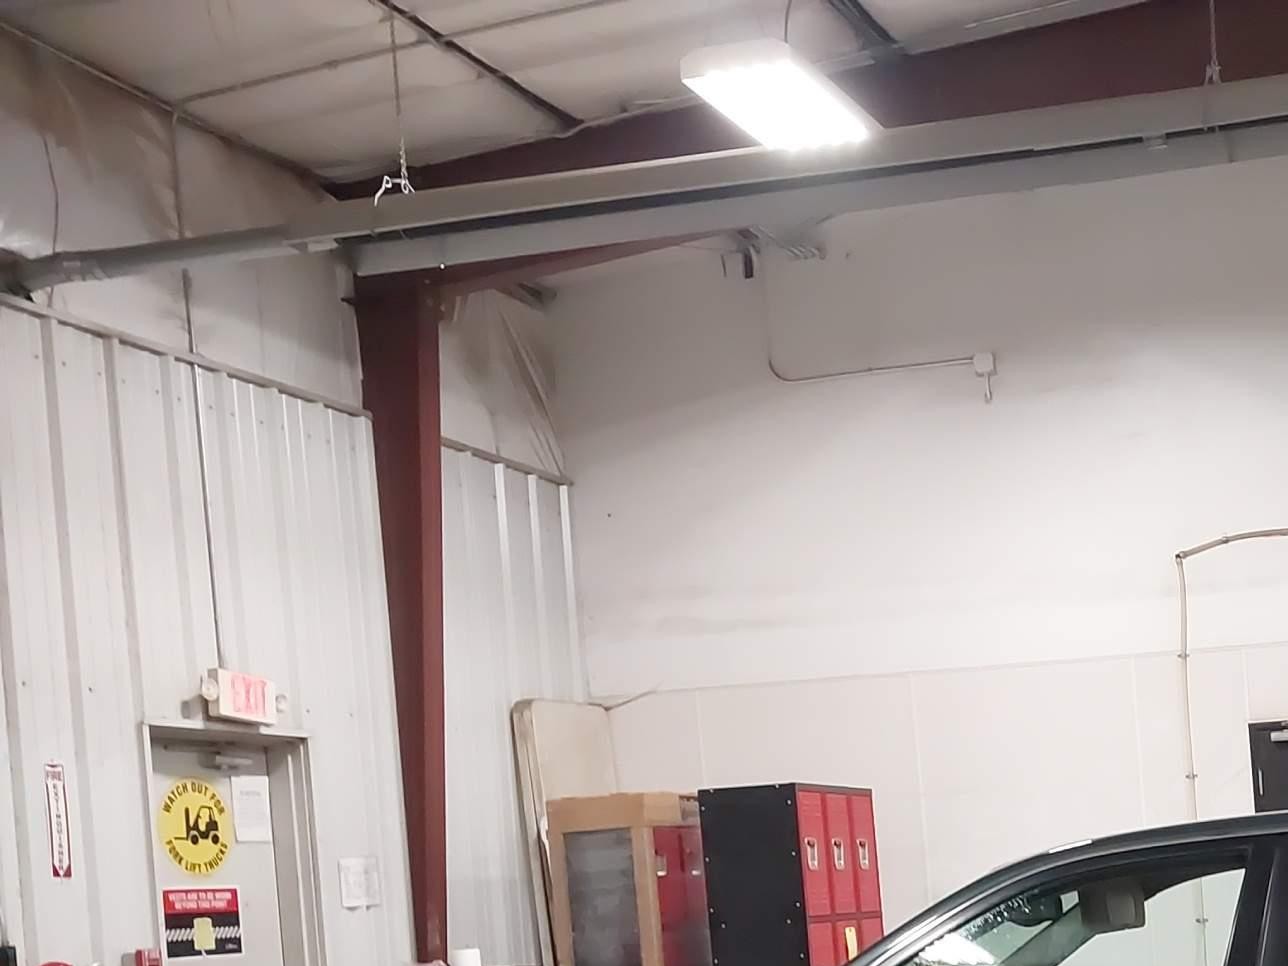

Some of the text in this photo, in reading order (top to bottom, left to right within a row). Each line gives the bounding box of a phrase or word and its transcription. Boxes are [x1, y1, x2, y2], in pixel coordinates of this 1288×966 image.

[230, 673, 267, 717] EXIT
[163, 781, 225, 816] WATCH OUT FOR
[165, 839, 228, 873] FORK LIFT TRUCKS
